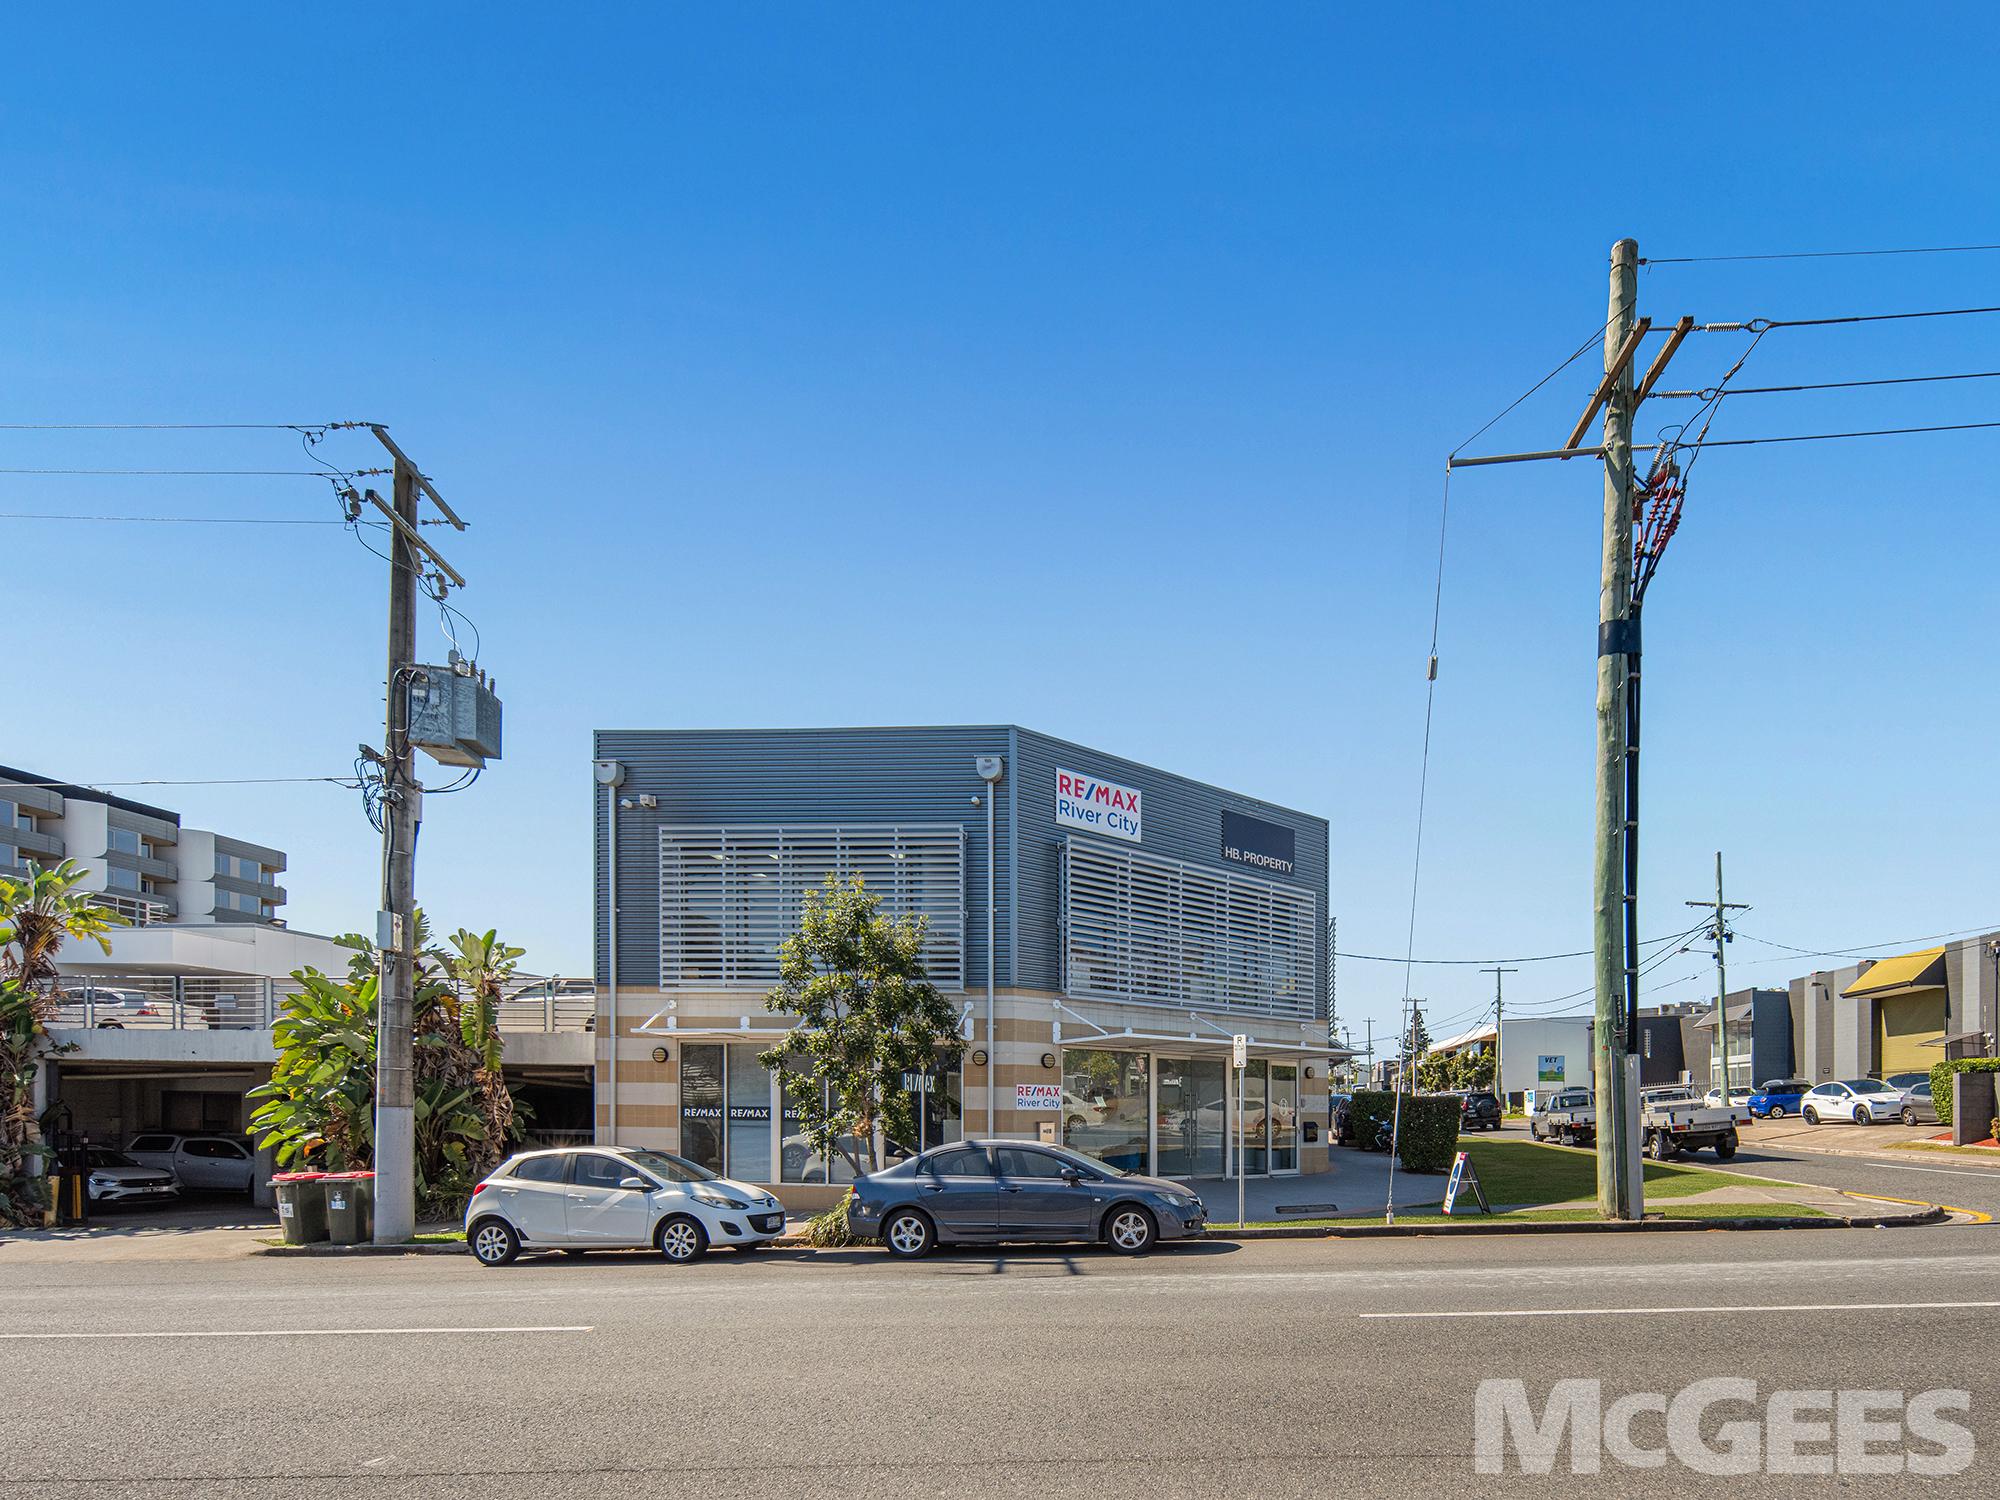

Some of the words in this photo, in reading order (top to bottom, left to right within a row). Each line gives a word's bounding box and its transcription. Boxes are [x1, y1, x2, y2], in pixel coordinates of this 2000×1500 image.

[1059, 773, 1138, 814] RE/MAX
[1059, 798, 1102, 824] River
[1107, 812, 1138, 836] City
[1225, 846, 1242, 861] HB.
[1243, 850, 1293, 873] PROPERTY
[1544, 1056, 1559, 1064] VET
[1017, 1086, 1060, 1097] RE/MAX
[1017, 1098, 1041, 1107] River
[1042, 1098, 1061, 1109] City
[684, 1108, 722, 1118] RE/MAX
[730, 1108, 768, 1118] RE/MAX
